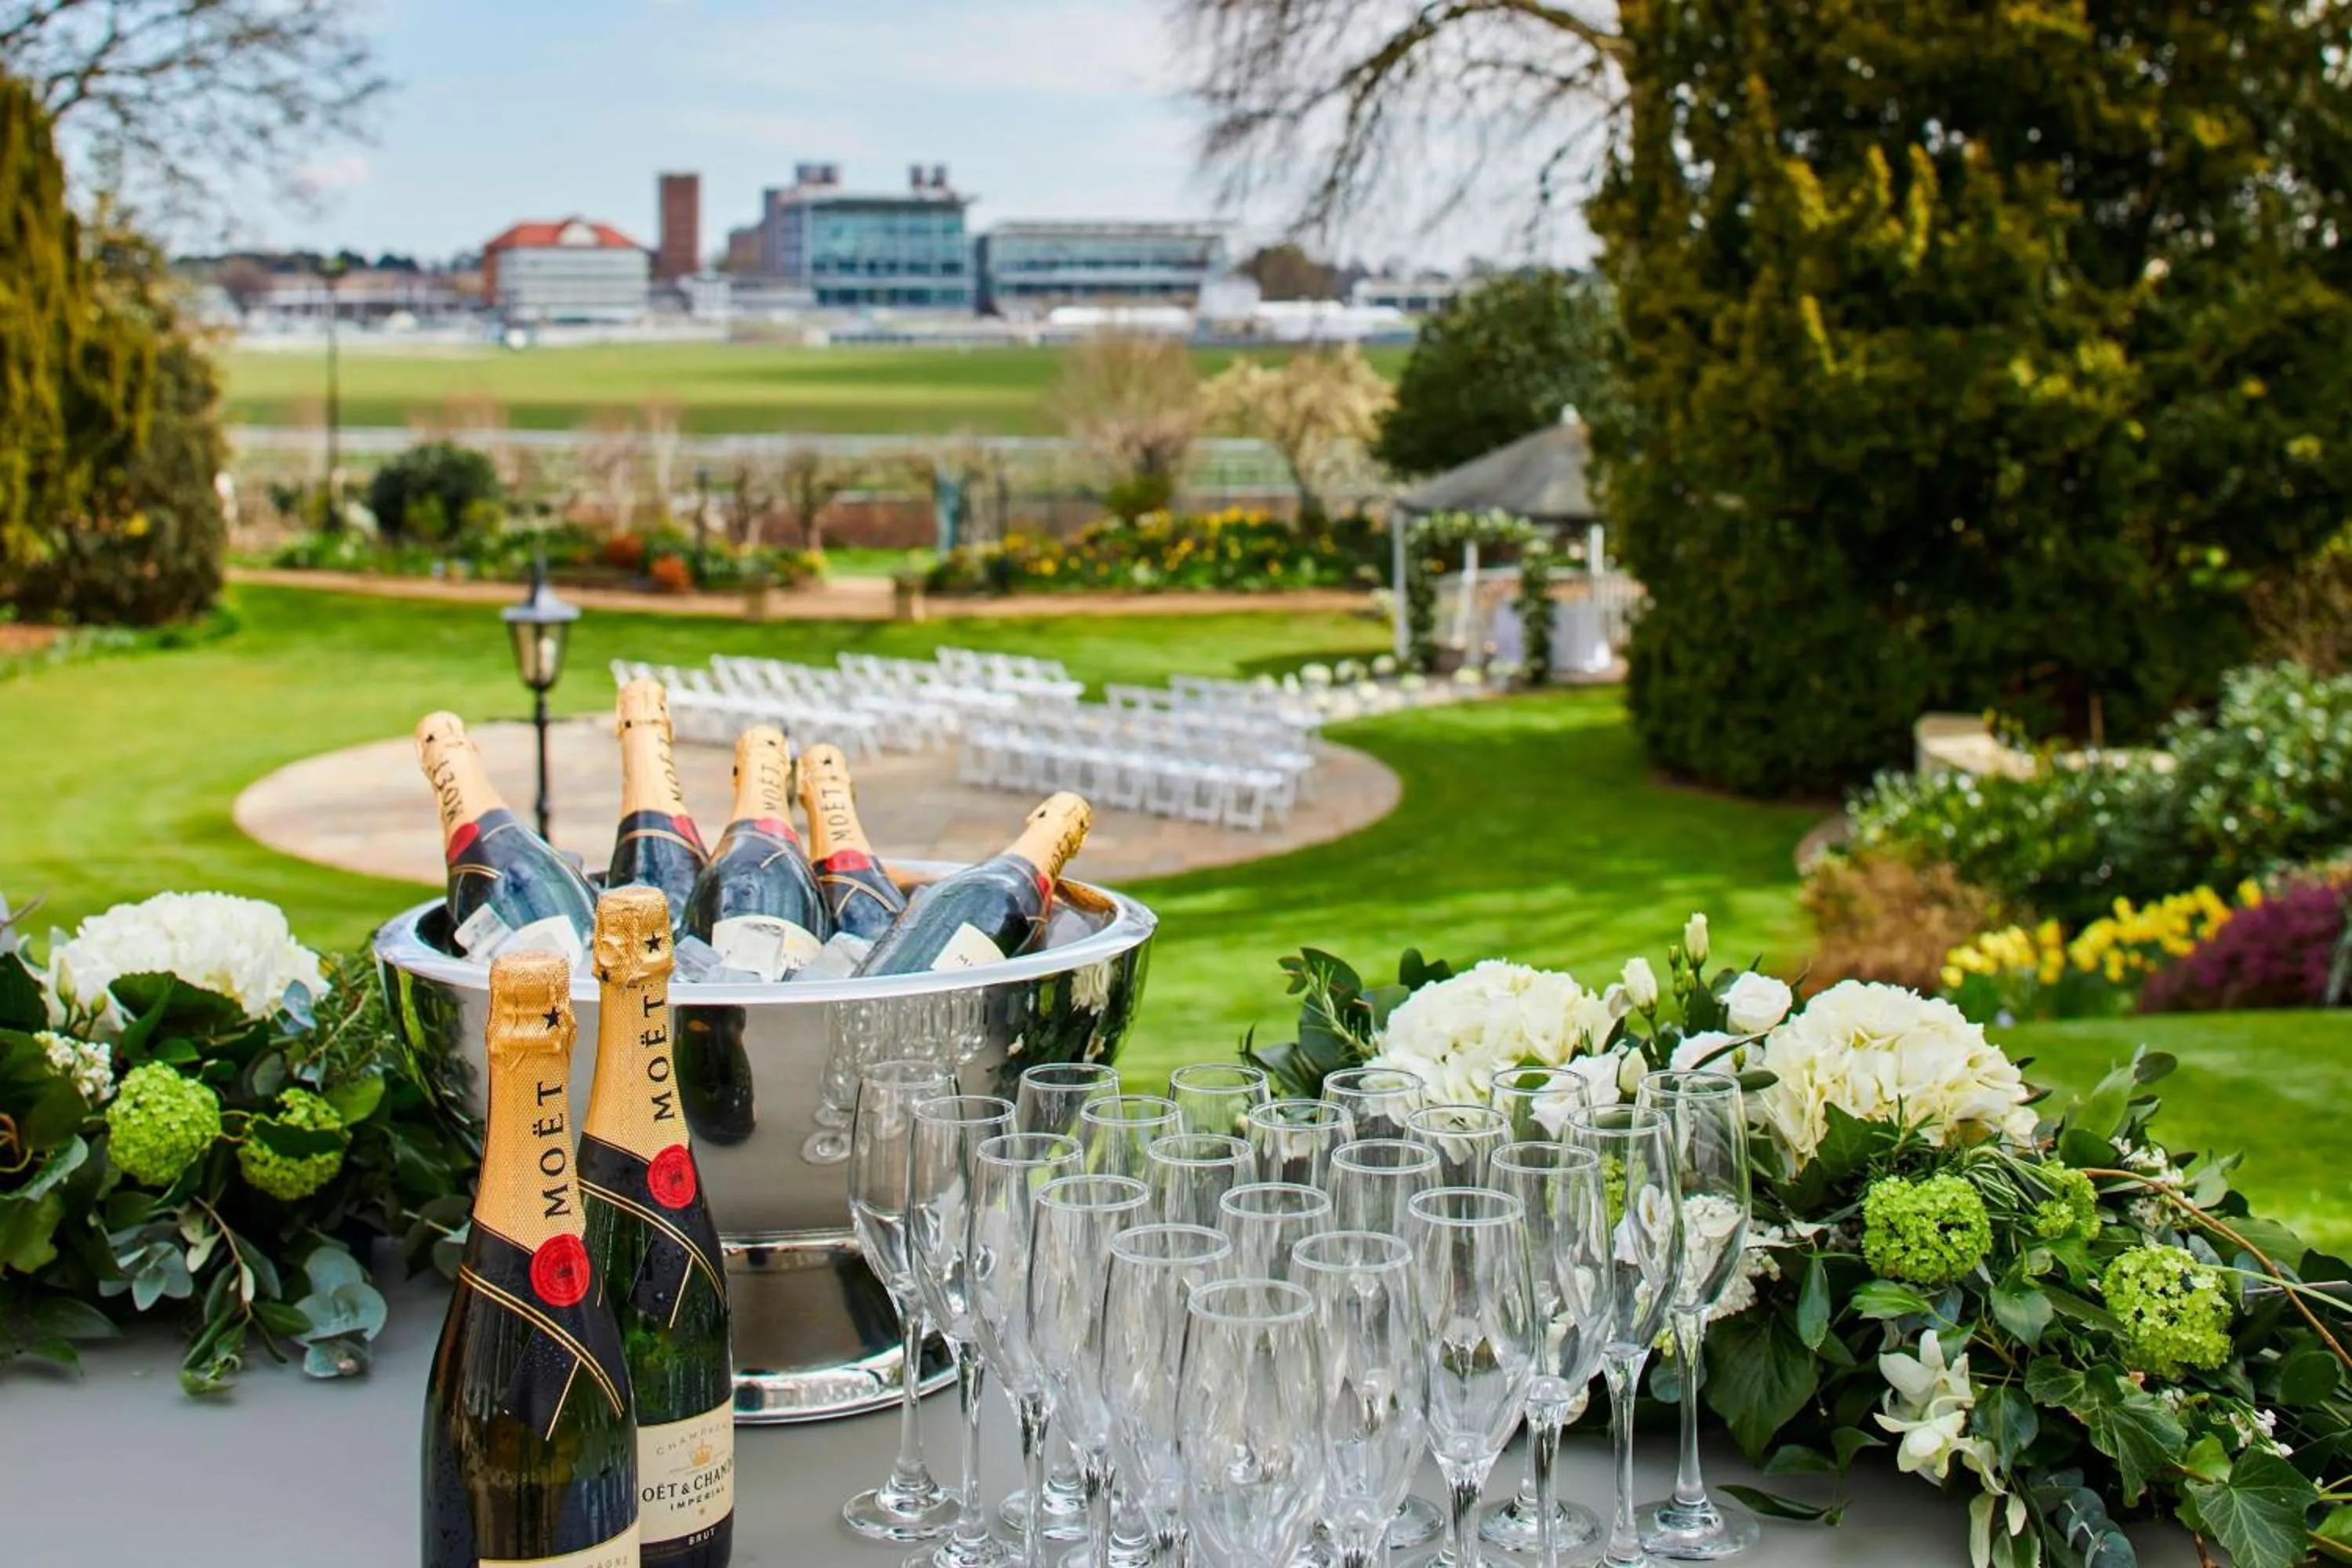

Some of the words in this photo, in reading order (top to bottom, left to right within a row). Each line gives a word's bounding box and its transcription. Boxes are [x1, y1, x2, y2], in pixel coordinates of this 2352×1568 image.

[640, 996, 675, 1122] MOËT
[532, 1080, 572, 1220] MOËT
[641, 1482, 678, 1503] OËT
[681, 1481, 691, 1495] &
[688, 1527, 716, 1546] BRUT
